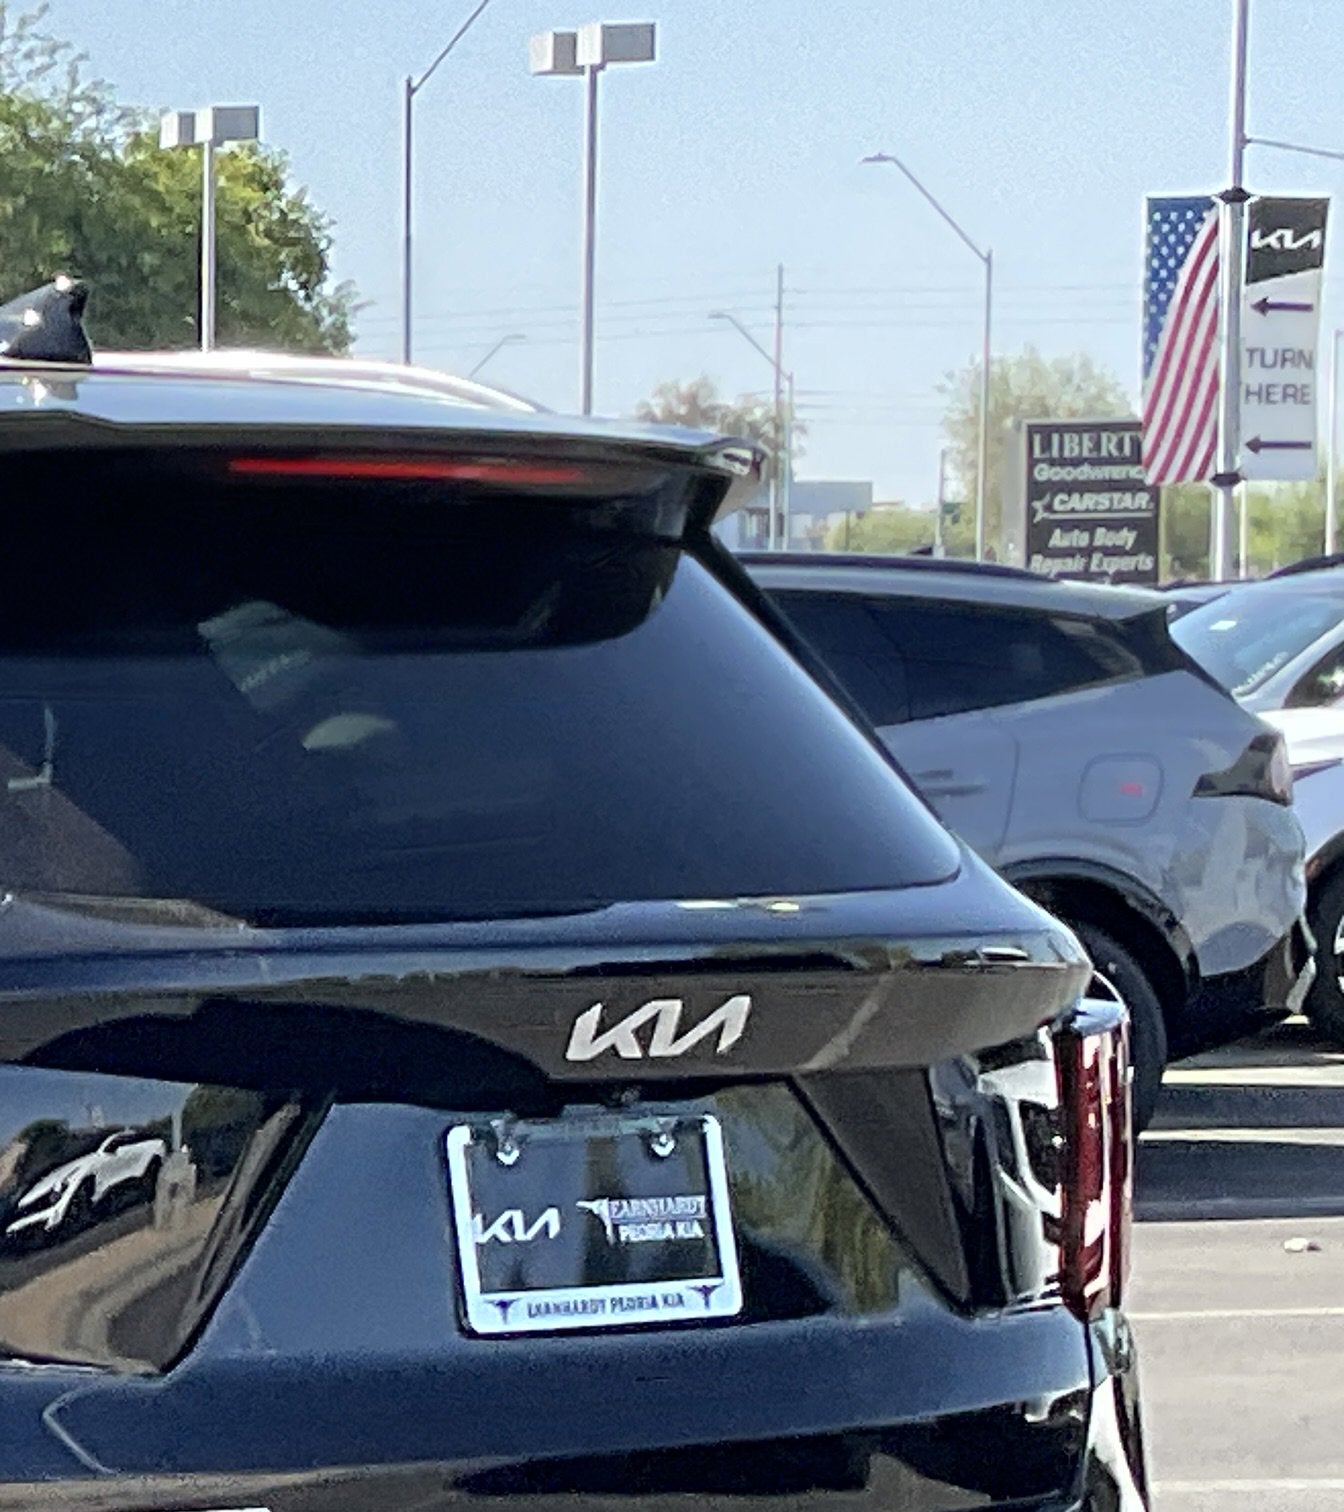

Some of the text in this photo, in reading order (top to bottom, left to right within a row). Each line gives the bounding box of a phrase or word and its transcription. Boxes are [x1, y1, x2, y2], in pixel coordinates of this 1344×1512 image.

[1245, 346, 1314, 370] TURN
[1244, 382, 1312, 406] HERE
[1048, 526, 1138, 551] Auto Body
[1029, 552, 1155, 578] Repair Experts
[565, 994, 752, 1062] KIA
[675, 1219, 706, 1239] KIA
